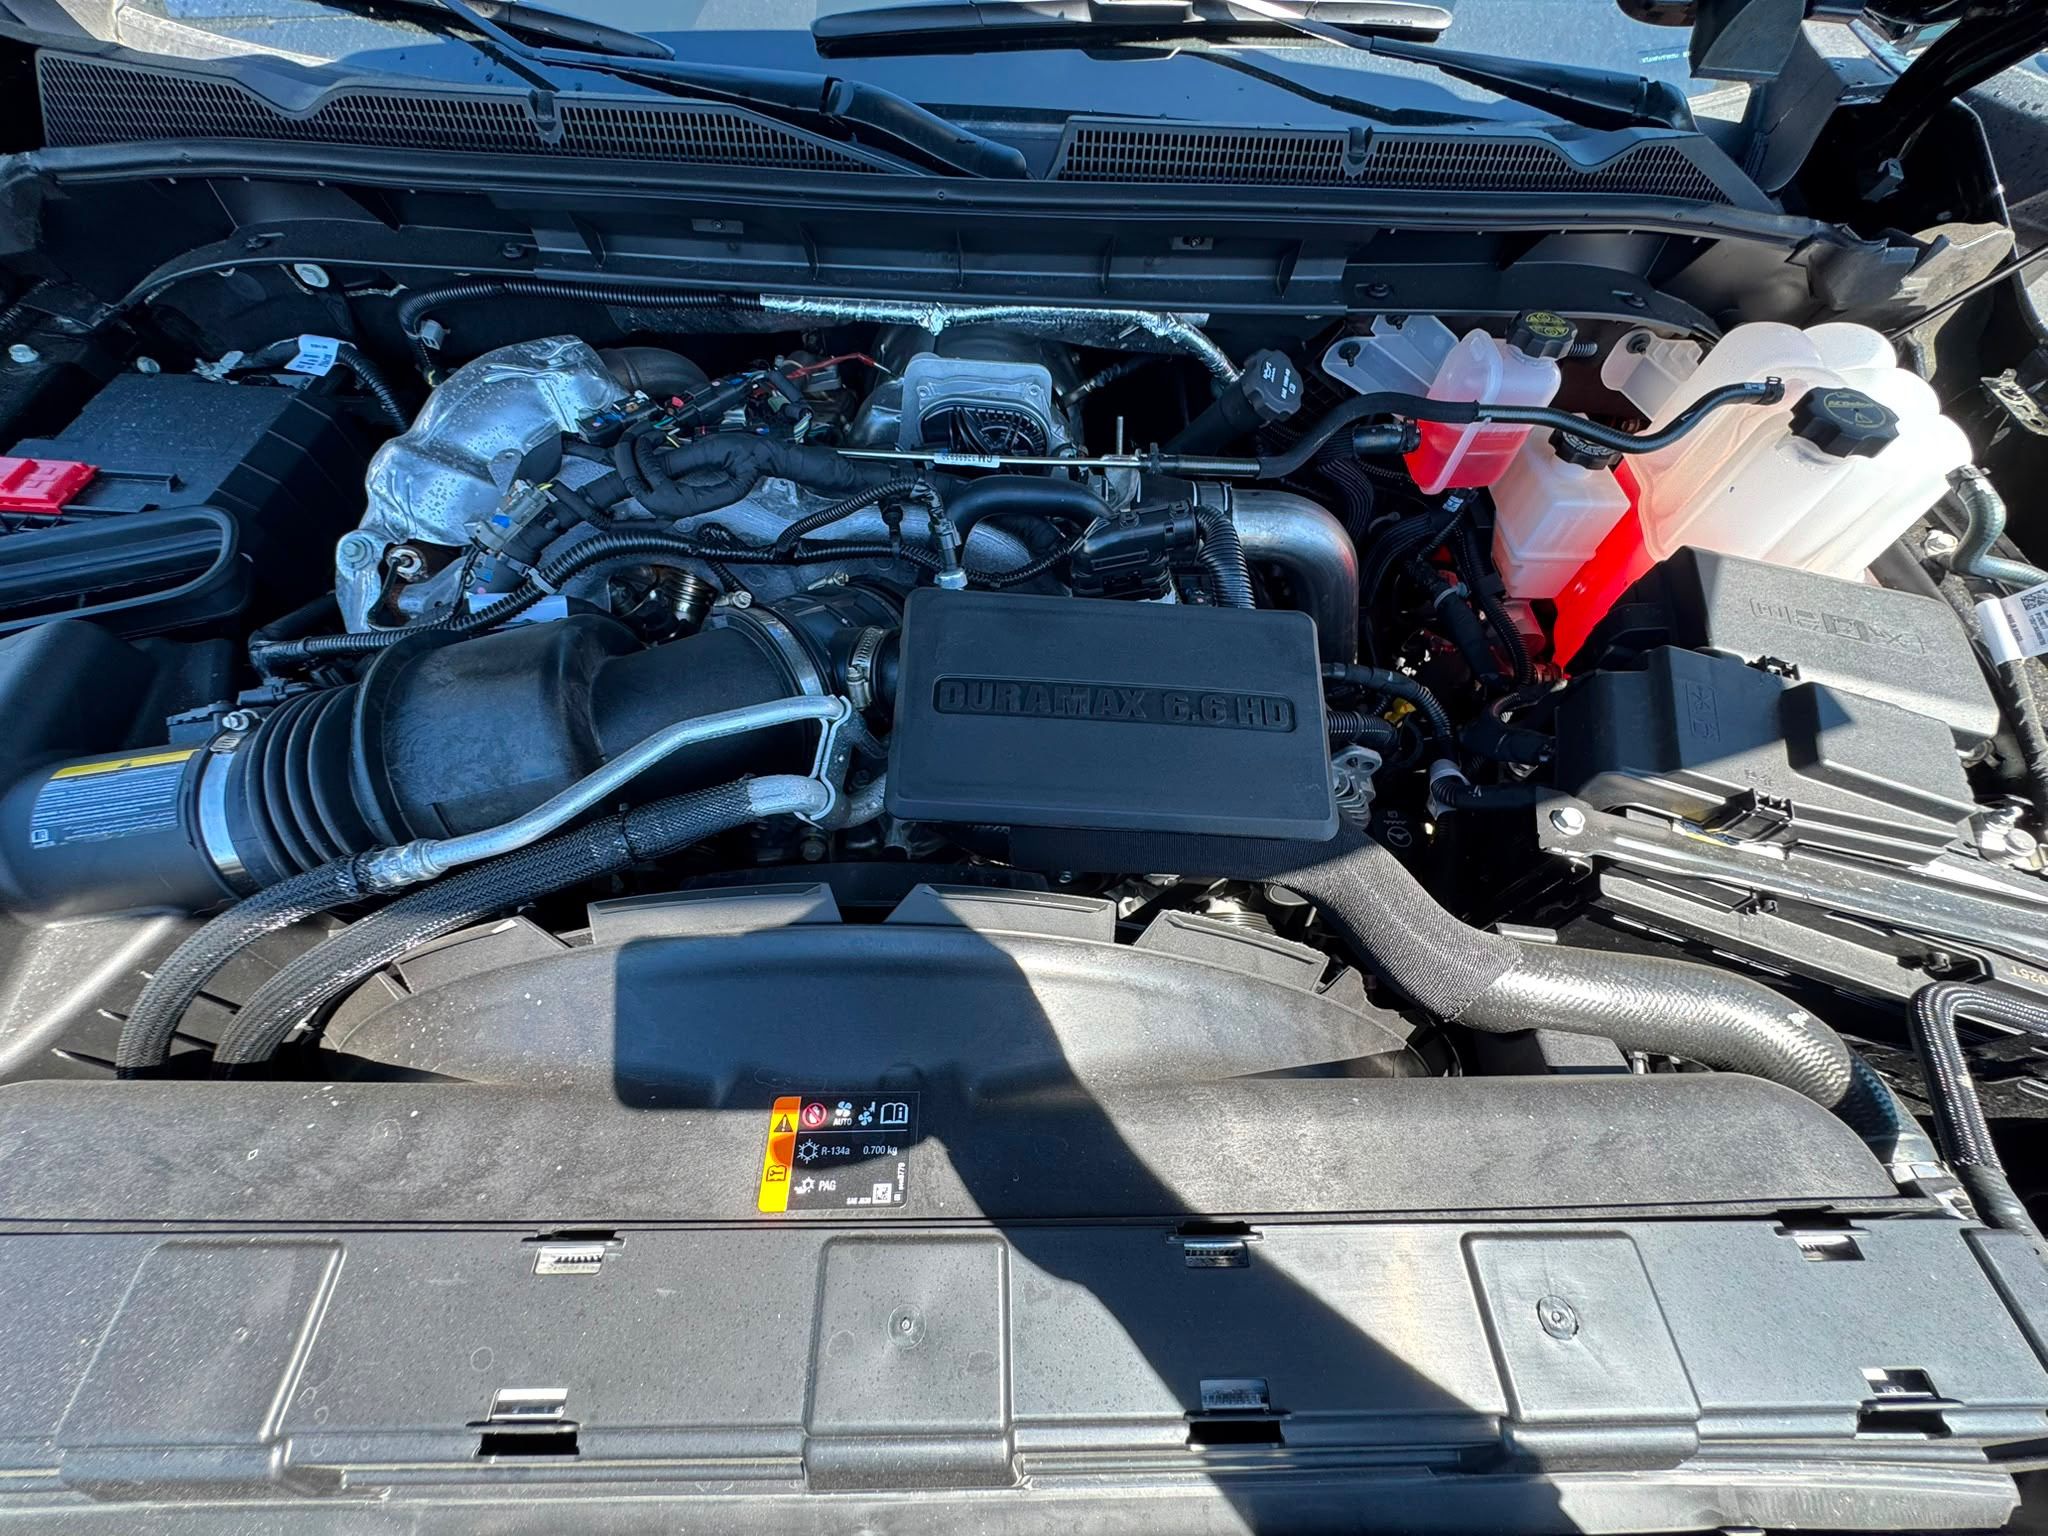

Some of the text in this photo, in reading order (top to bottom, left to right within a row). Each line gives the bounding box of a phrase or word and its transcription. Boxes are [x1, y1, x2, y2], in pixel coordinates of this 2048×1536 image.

[938, 679, 1293, 730] DURAMAX 6.6 HD
[833, 1118, 853, 1127] AUTO
[821, 1145, 898, 1156] R-134a 0.700 kg
[818, 1180, 837, 1191] PAG
